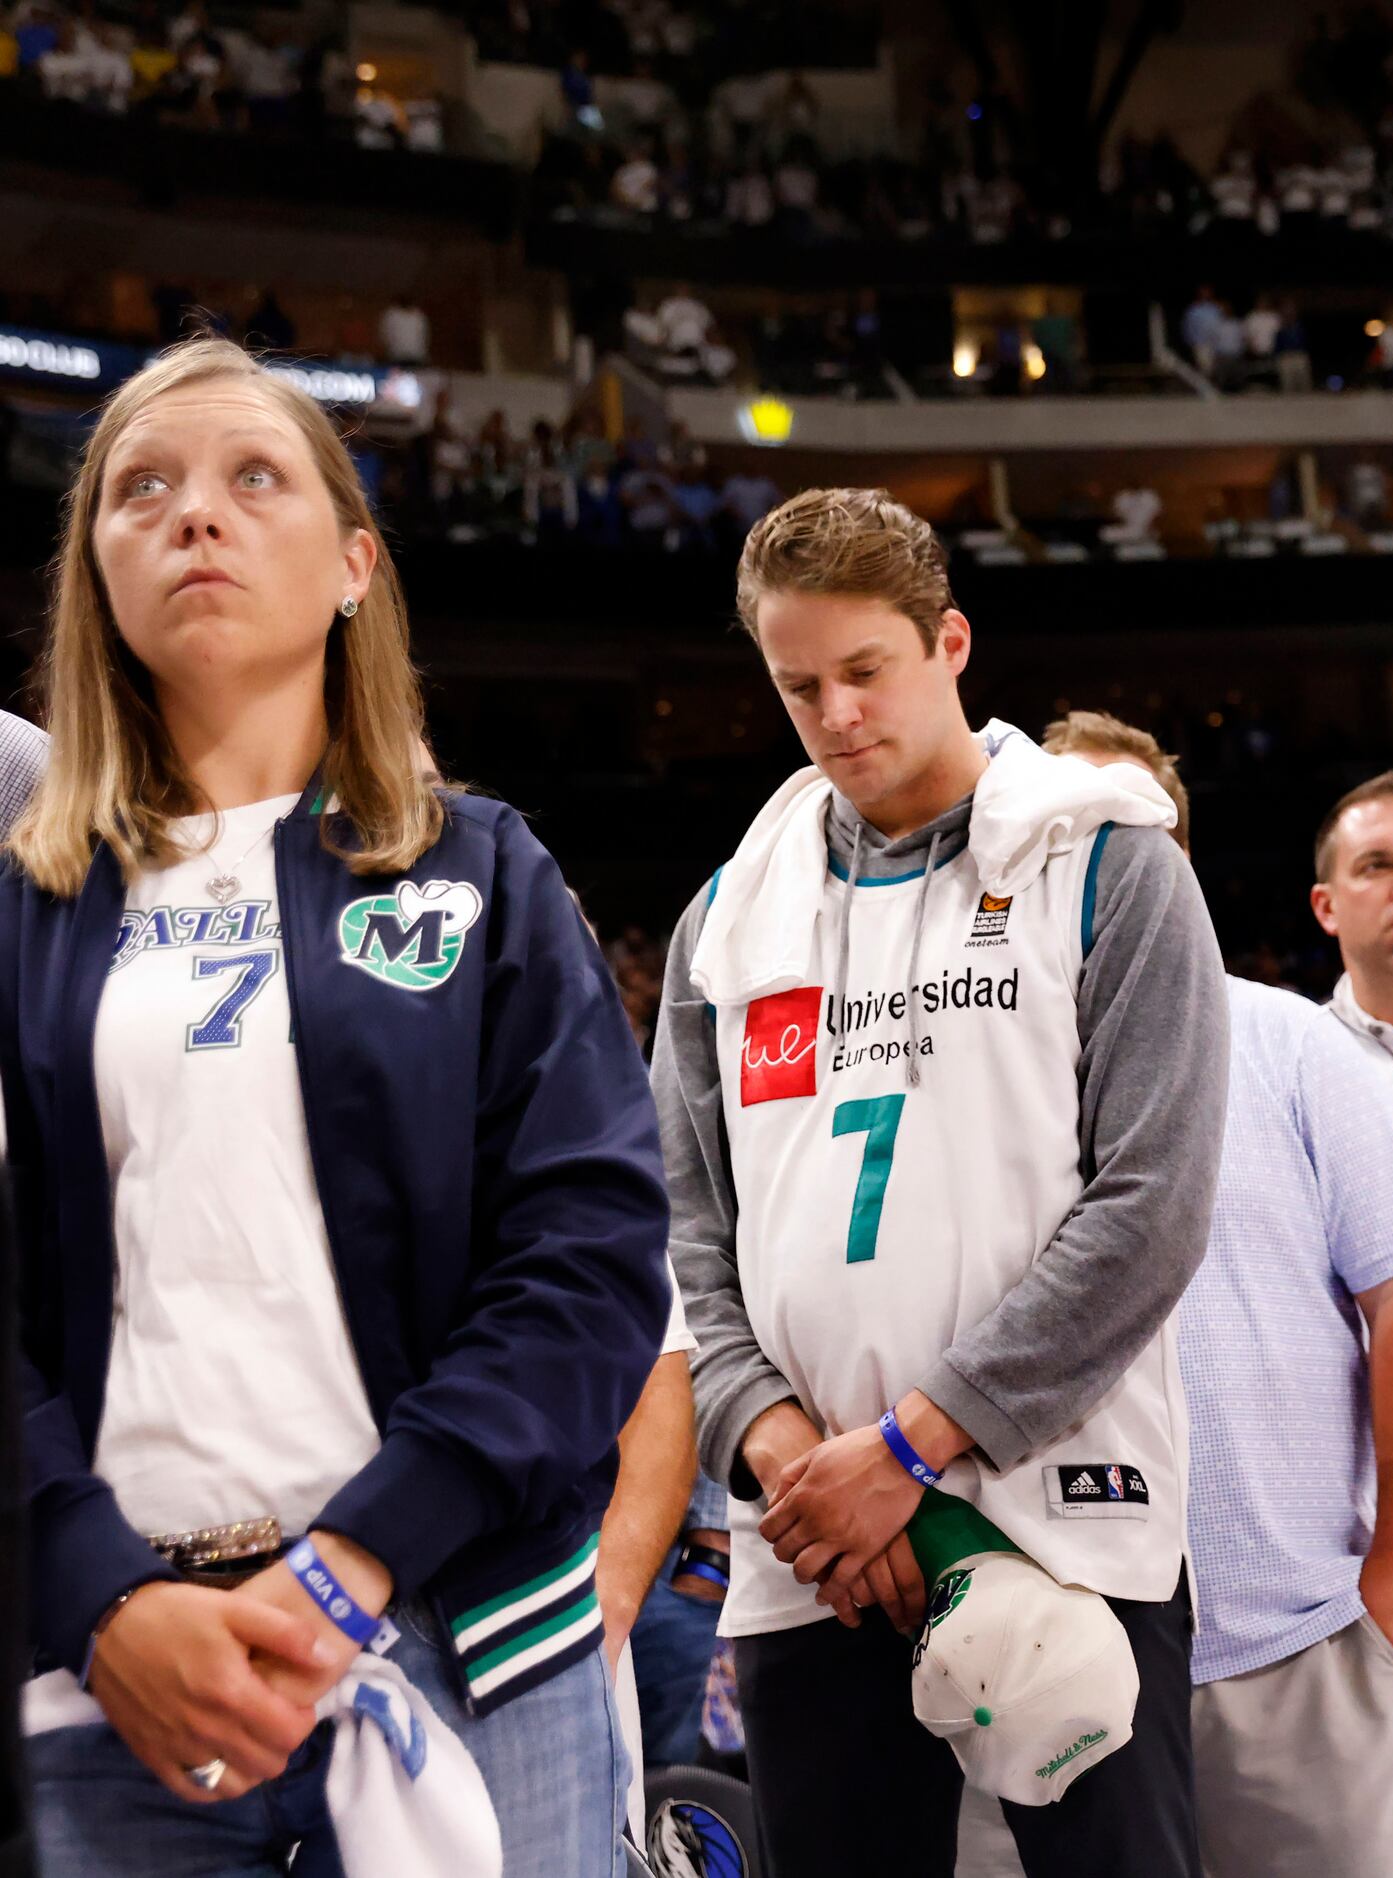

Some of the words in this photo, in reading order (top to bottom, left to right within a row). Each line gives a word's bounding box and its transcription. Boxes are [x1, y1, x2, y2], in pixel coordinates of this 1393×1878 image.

[184, 948, 280, 1053] 7
[832, 1093, 906, 1264] 7
[1068, 1485, 1101, 1495] adidas
[1129, 1479, 1147, 1493] XXL
[305, 1568, 334, 1602] VIP
